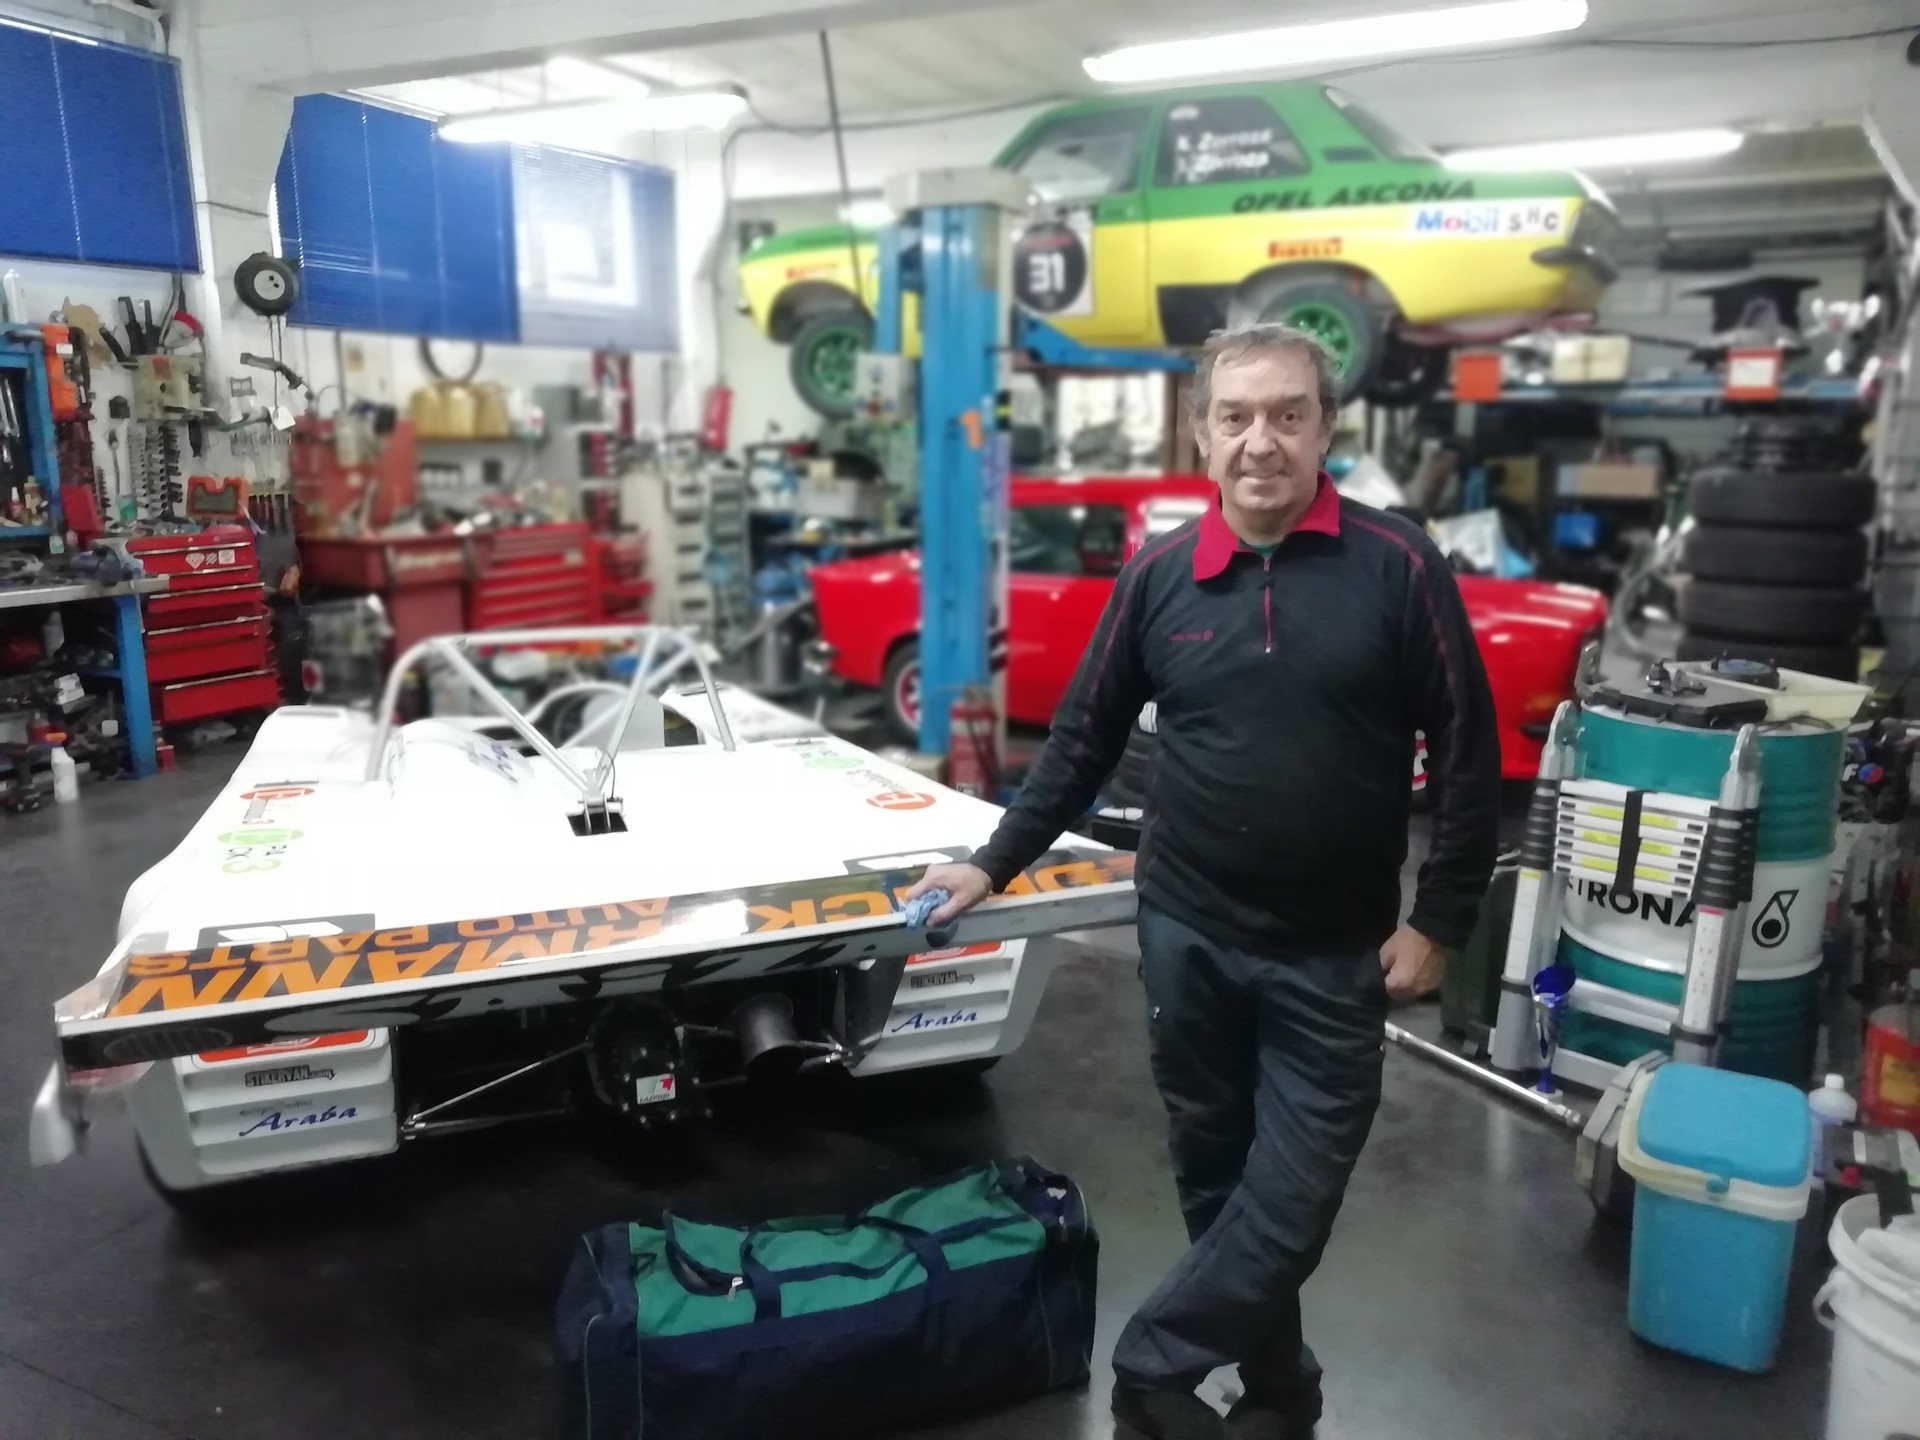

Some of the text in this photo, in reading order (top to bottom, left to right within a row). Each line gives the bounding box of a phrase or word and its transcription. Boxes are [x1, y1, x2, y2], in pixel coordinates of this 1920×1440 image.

[1233, 180, 1476, 214] OPEL ASCONA
[1415, 208, 1499, 233] Mobil
[1267, 237, 1343, 259] PIRELLI
[1028, 252, 1066, 294] 31
[457, 896, 670, 938] AUTO
[128, 926, 430, 976] PARTS
[891, 1010, 978, 1033] Araba
[238, 1104, 359, 1137] Araba
